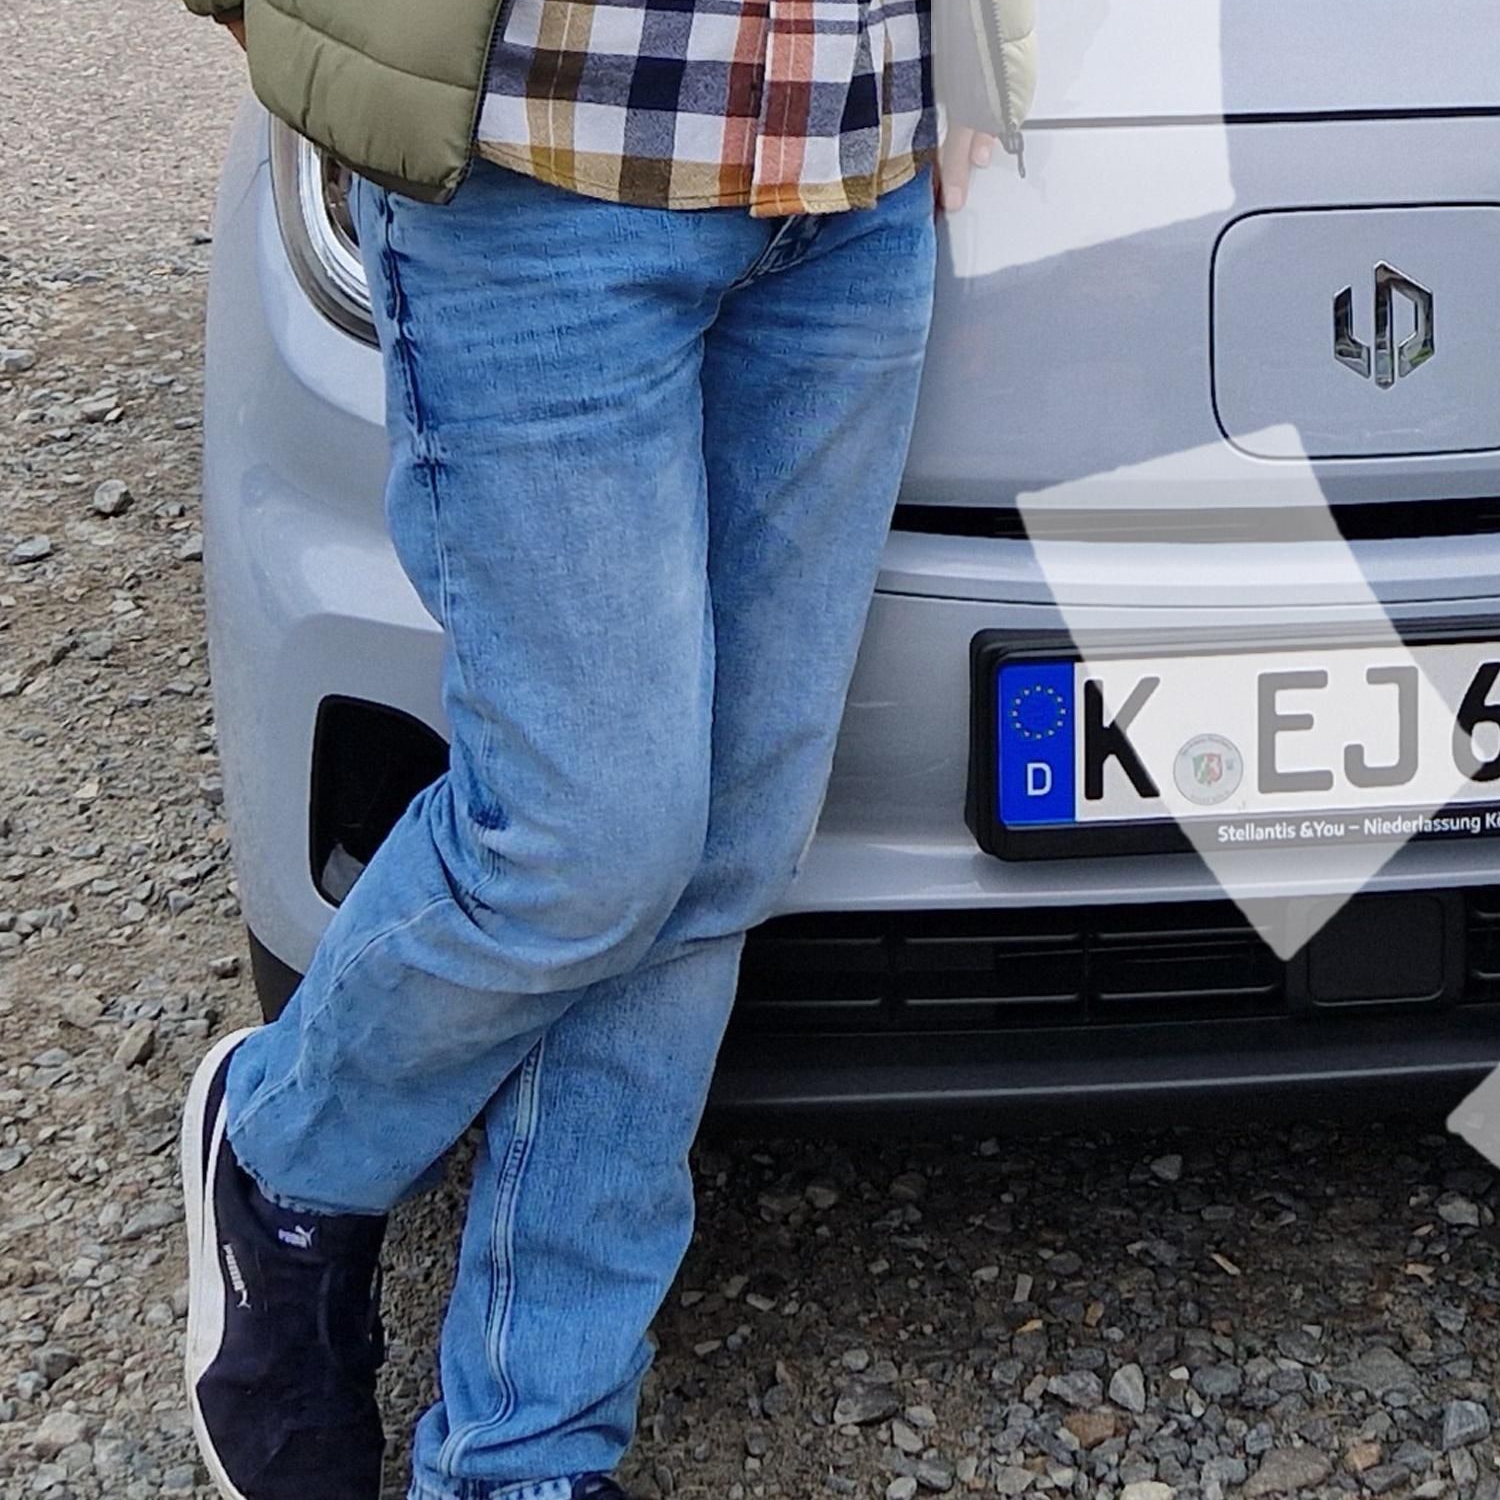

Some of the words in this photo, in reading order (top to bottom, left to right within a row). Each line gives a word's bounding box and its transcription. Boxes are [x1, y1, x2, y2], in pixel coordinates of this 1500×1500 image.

[1083, 676, 1161, 801] K
[1257, 665, 1419, 794] EJ
[1026, 762, 1052, 797] D
[1217, 824, 1296, 843] Stellantis
[1299, 820, 1345, 839] &You
[1363, 814, 1482, 836] Niederlassung
